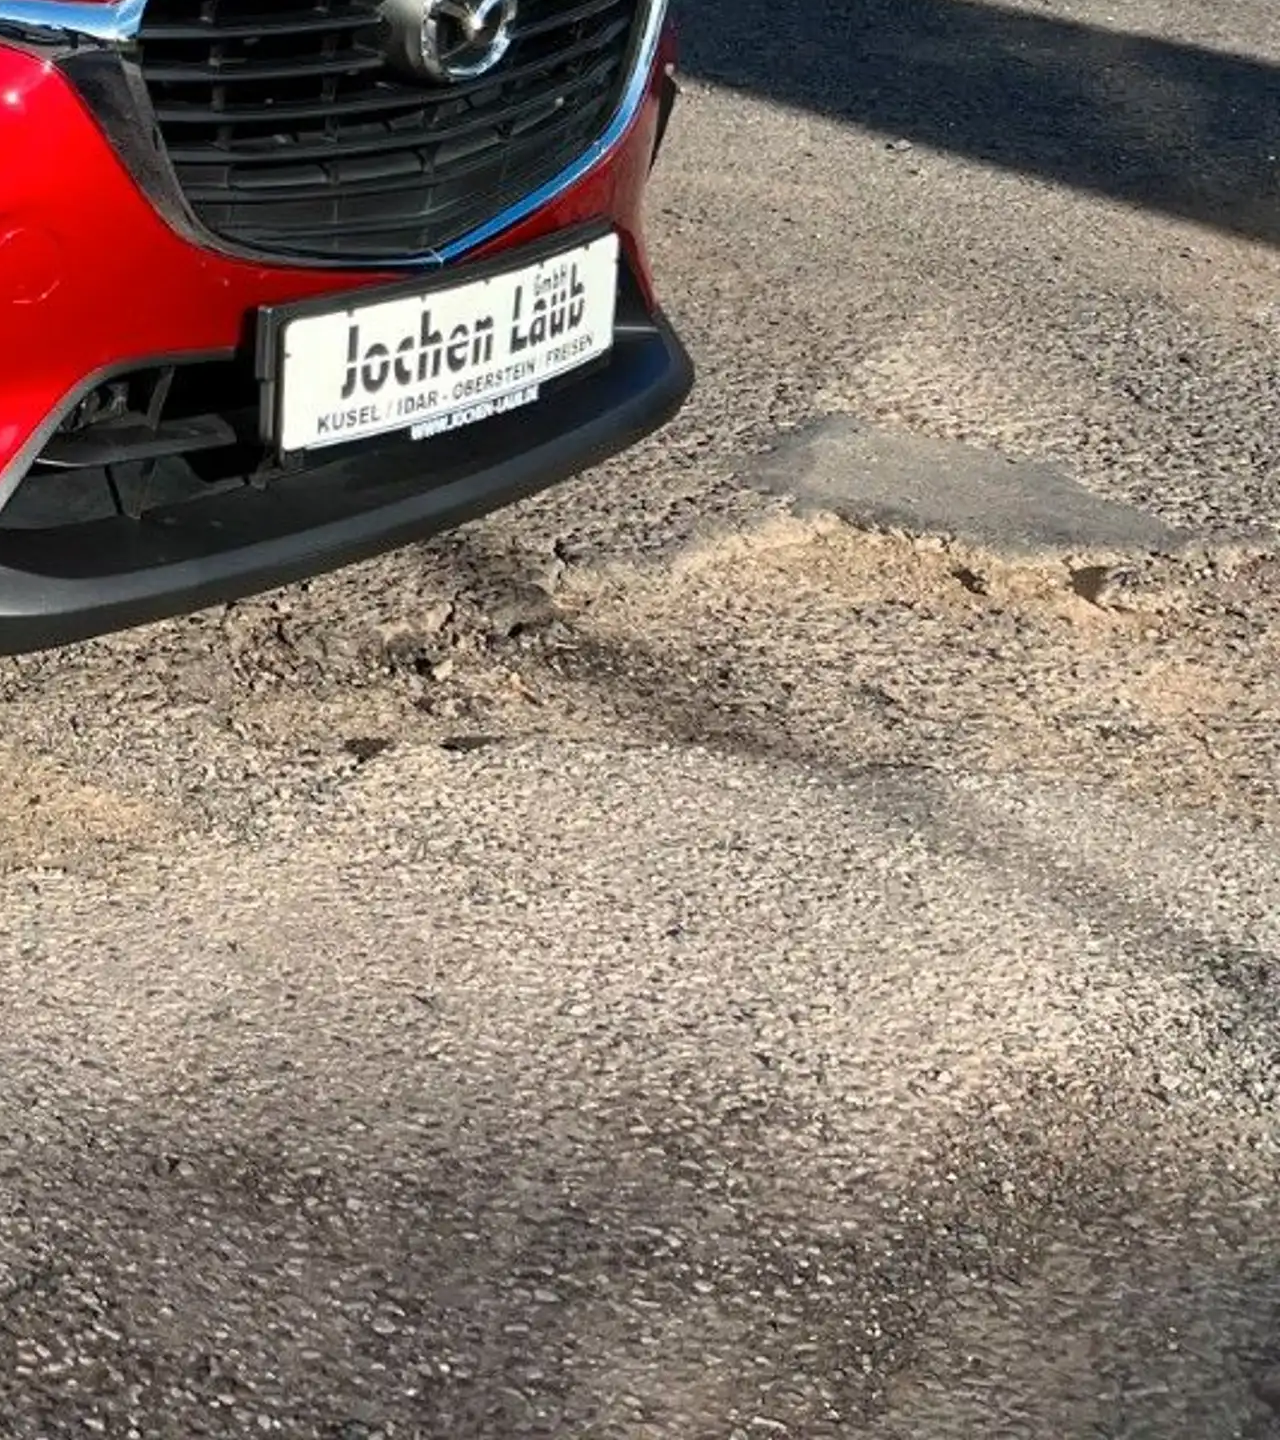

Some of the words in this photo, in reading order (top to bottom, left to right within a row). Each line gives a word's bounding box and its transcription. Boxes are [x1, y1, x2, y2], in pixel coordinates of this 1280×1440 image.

[316, 405, 381, 435] KUSEL
[396, 389, 439, 417] IDAR
[451, 359, 537, 401] OBERSTEIN
[545, 331, 595, 368] FREISEN
[341, 309, 495, 399] Jochen
[509, 262, 586, 355] Laub
